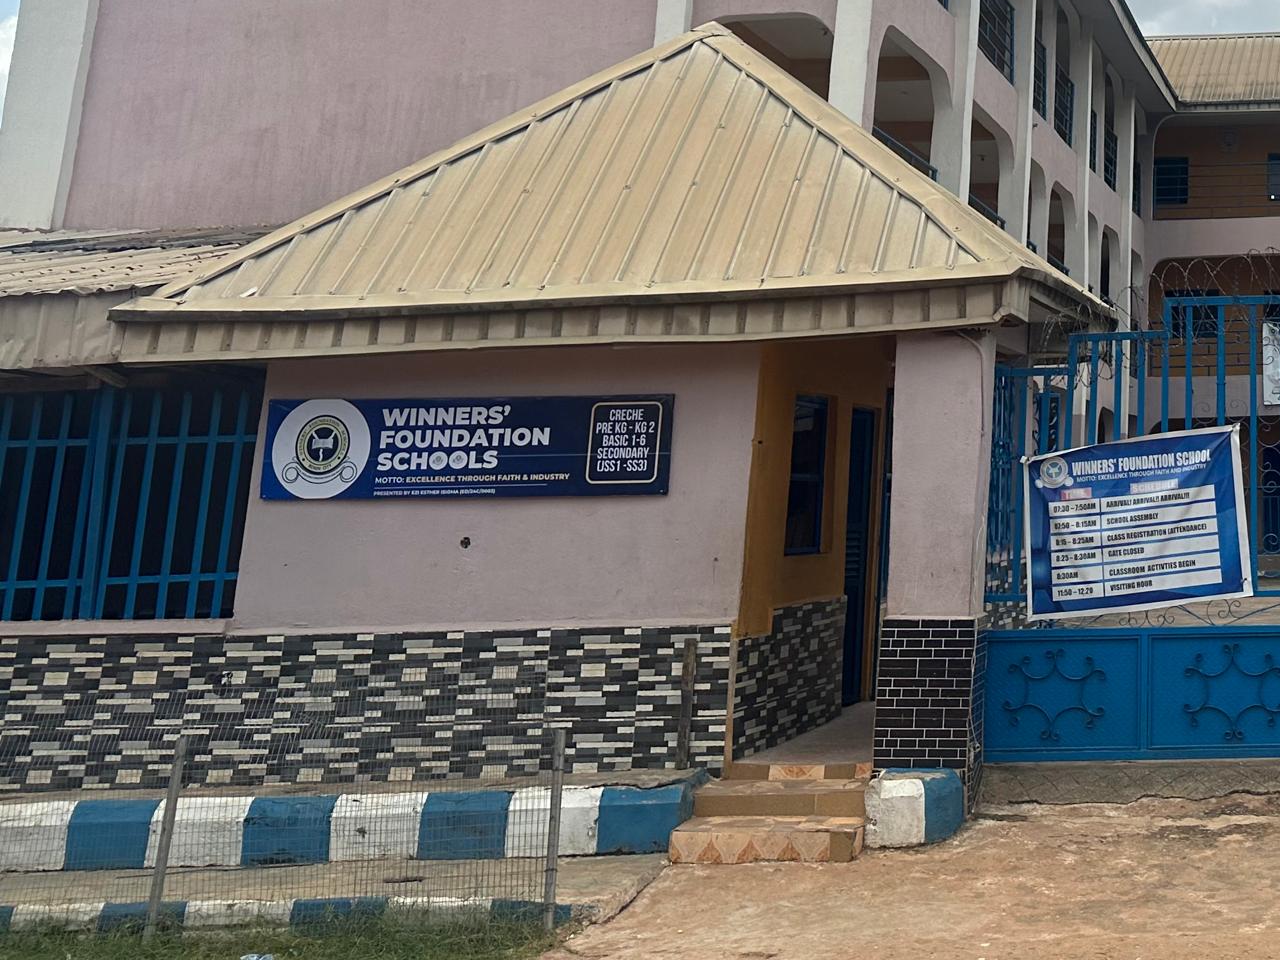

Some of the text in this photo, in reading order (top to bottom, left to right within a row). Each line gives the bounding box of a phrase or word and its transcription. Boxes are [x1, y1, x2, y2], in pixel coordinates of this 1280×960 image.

[383, 405, 511, 426] WINNERS'
[610, 409, 644, 420] CRECHE
[596, 422, 613, 434] PRE
[615, 422, 627, 433] KG
[635, 422, 647, 433] KG
[649, 421, 655, 433] 2
[380, 428, 550, 448] FOUNDATION
[602, 434, 646, 446] BASIC 1-6
[597, 447, 650, 459] SECONDARY
[376, 450, 498, 471] SCHOOLS
[1072, 449, 1211, 476] WINNERS' FOUNDATION SCHOOL
[1183, 464, 1206, 472] INDUSTRY
[375, 476, 404, 484] MOTTO:
[1054, 505, 1069, 513] 07:30
[1075, 503, 1096, 511] 7:50AM
[1107, 513, 1158, 525] SCHOOL ASSEMBLY
[1127, 529, 1166, 540] REGISTRATION
[1168, 524, 1207, 534] (ATTENDANCE)
[1108, 547, 1144, 557] GATE CLOSED
[1109, 566, 1145, 576] CLASSROOM
[1178, 560, 1196, 568] BEGIN
[1110, 580, 1152, 591] VISITING HOUR
